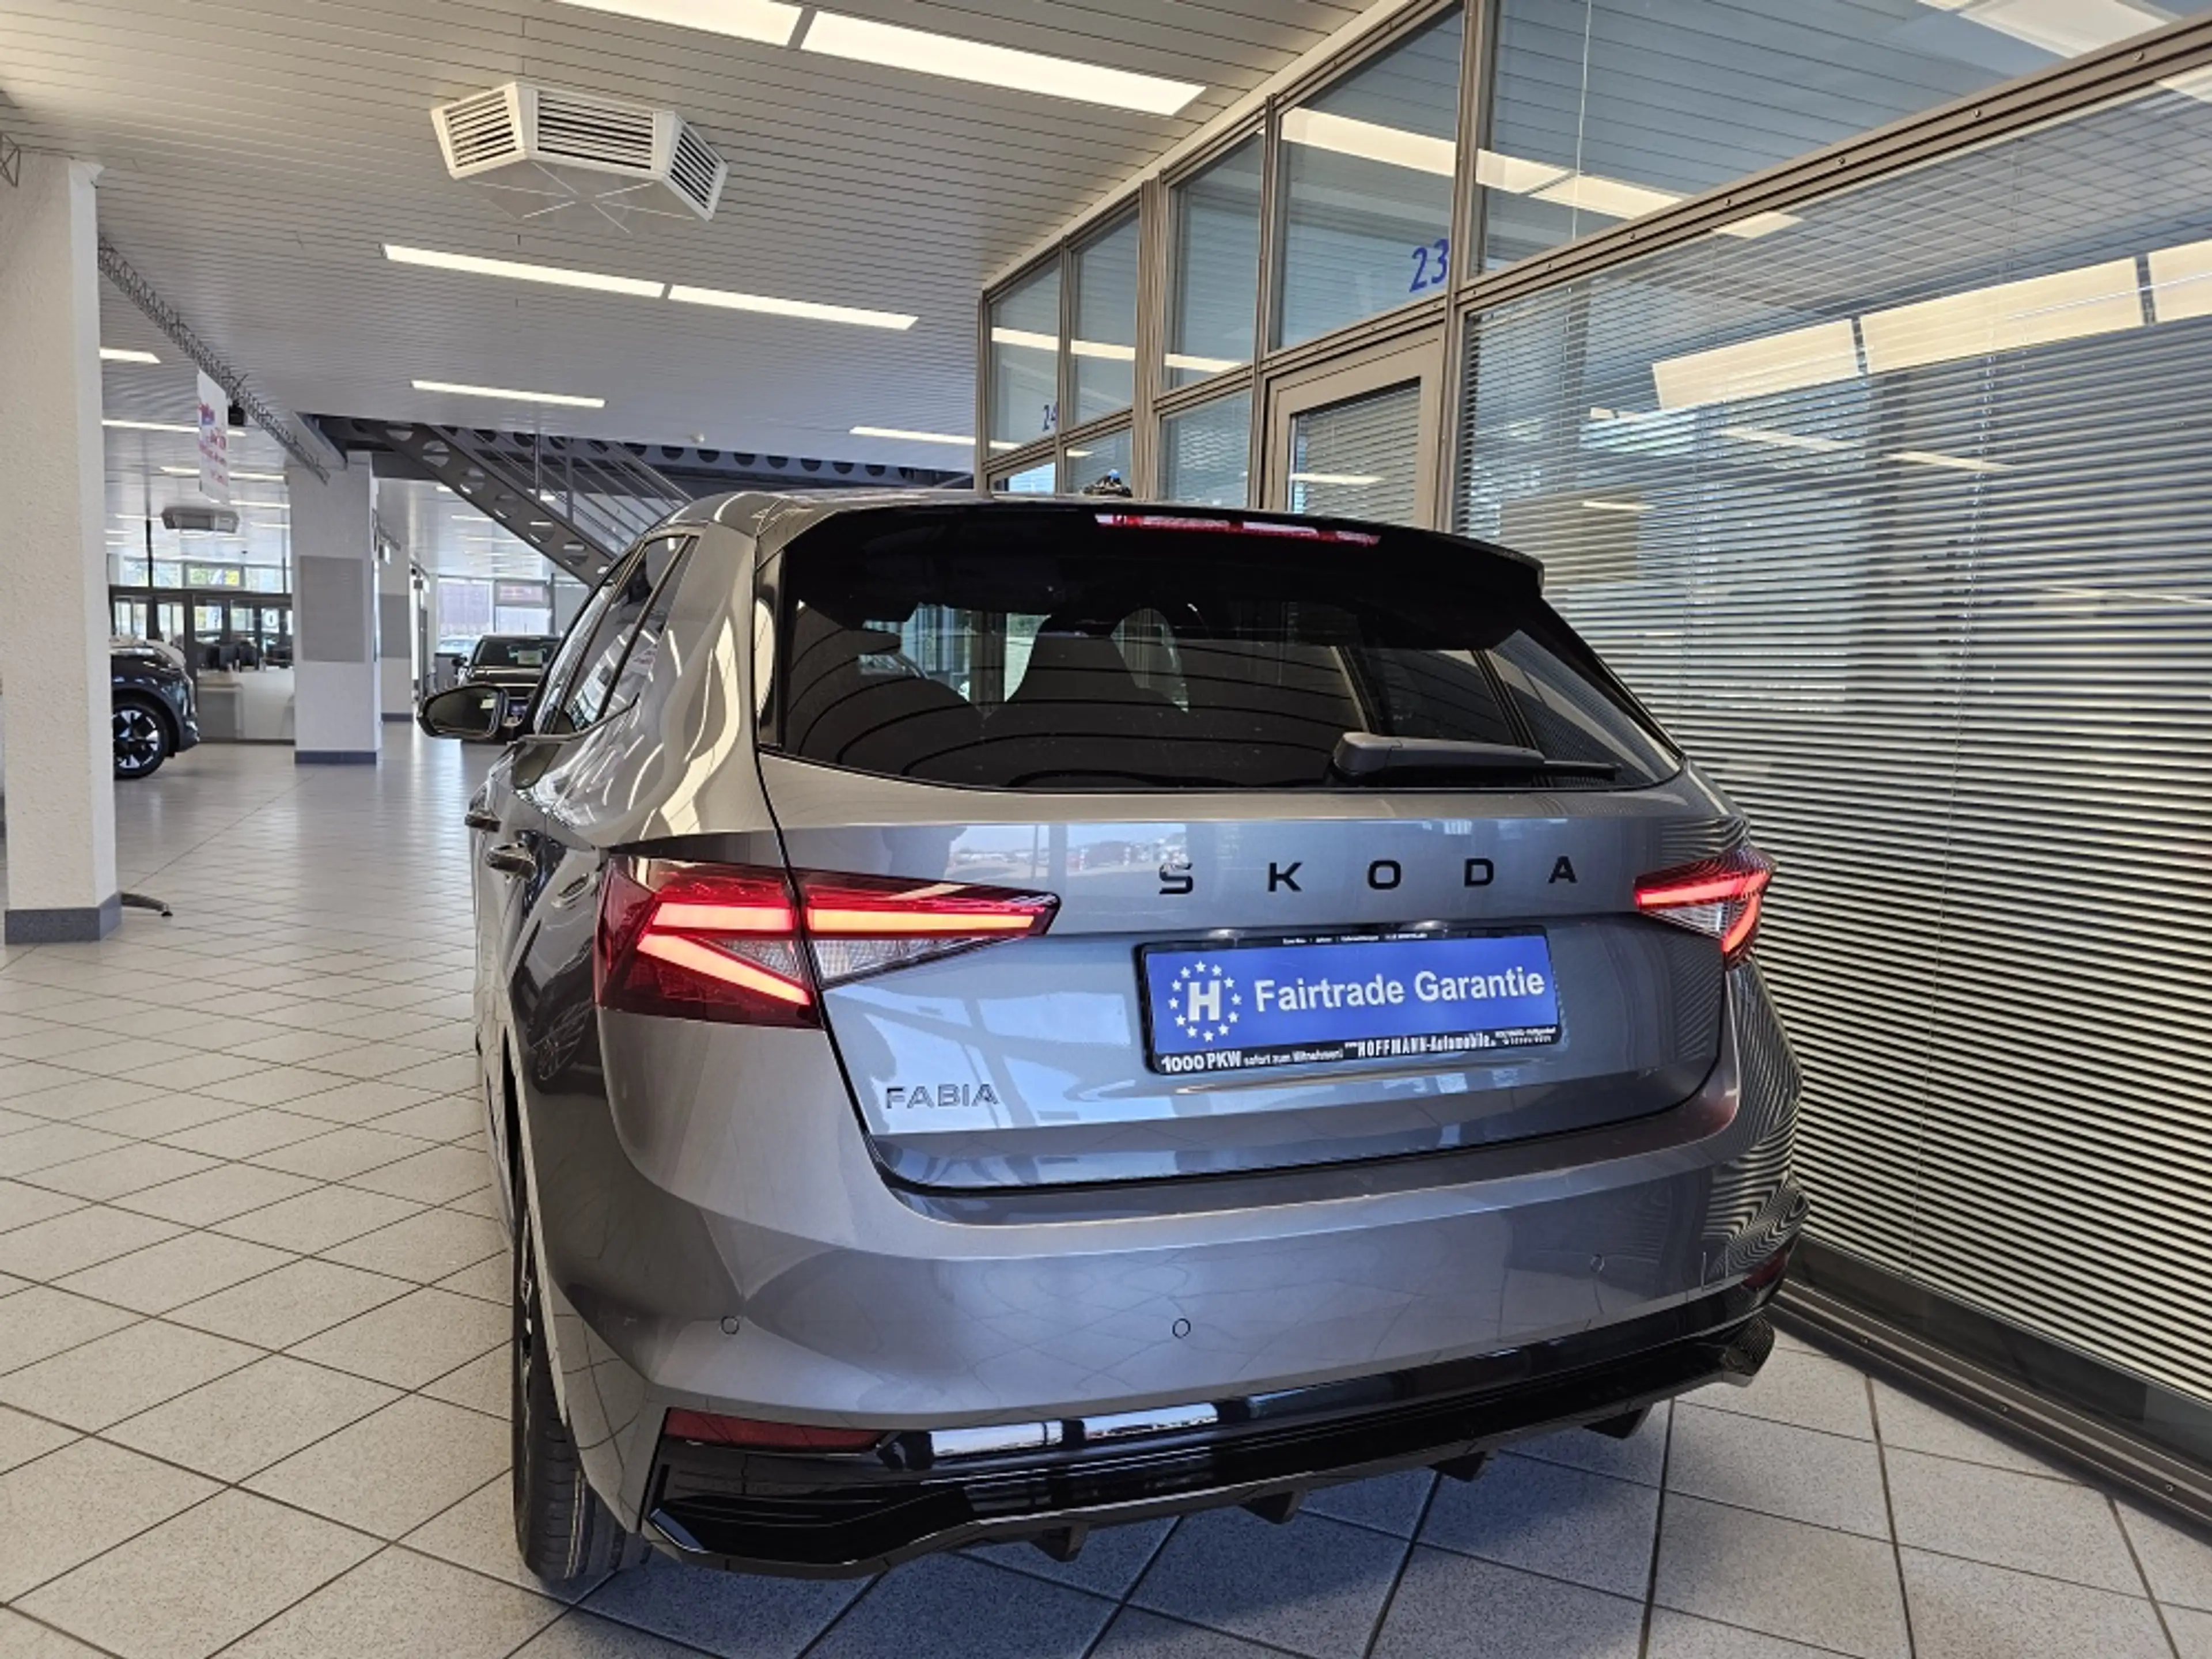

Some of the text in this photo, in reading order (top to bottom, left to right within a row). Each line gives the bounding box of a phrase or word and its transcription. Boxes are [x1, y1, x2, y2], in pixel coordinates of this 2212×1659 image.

[1409, 238, 1449, 293] 23
[1158, 856, 1578, 895] SKODA
[1187, 981, 1221, 1022] H
[1254, 966, 1546, 1013] Fairtrade Garantie
[1161, 1055, 1205, 1073] 1000
[1206, 1050, 1242, 1070] PKW
[885, 1084, 1000, 1109] FABIA
